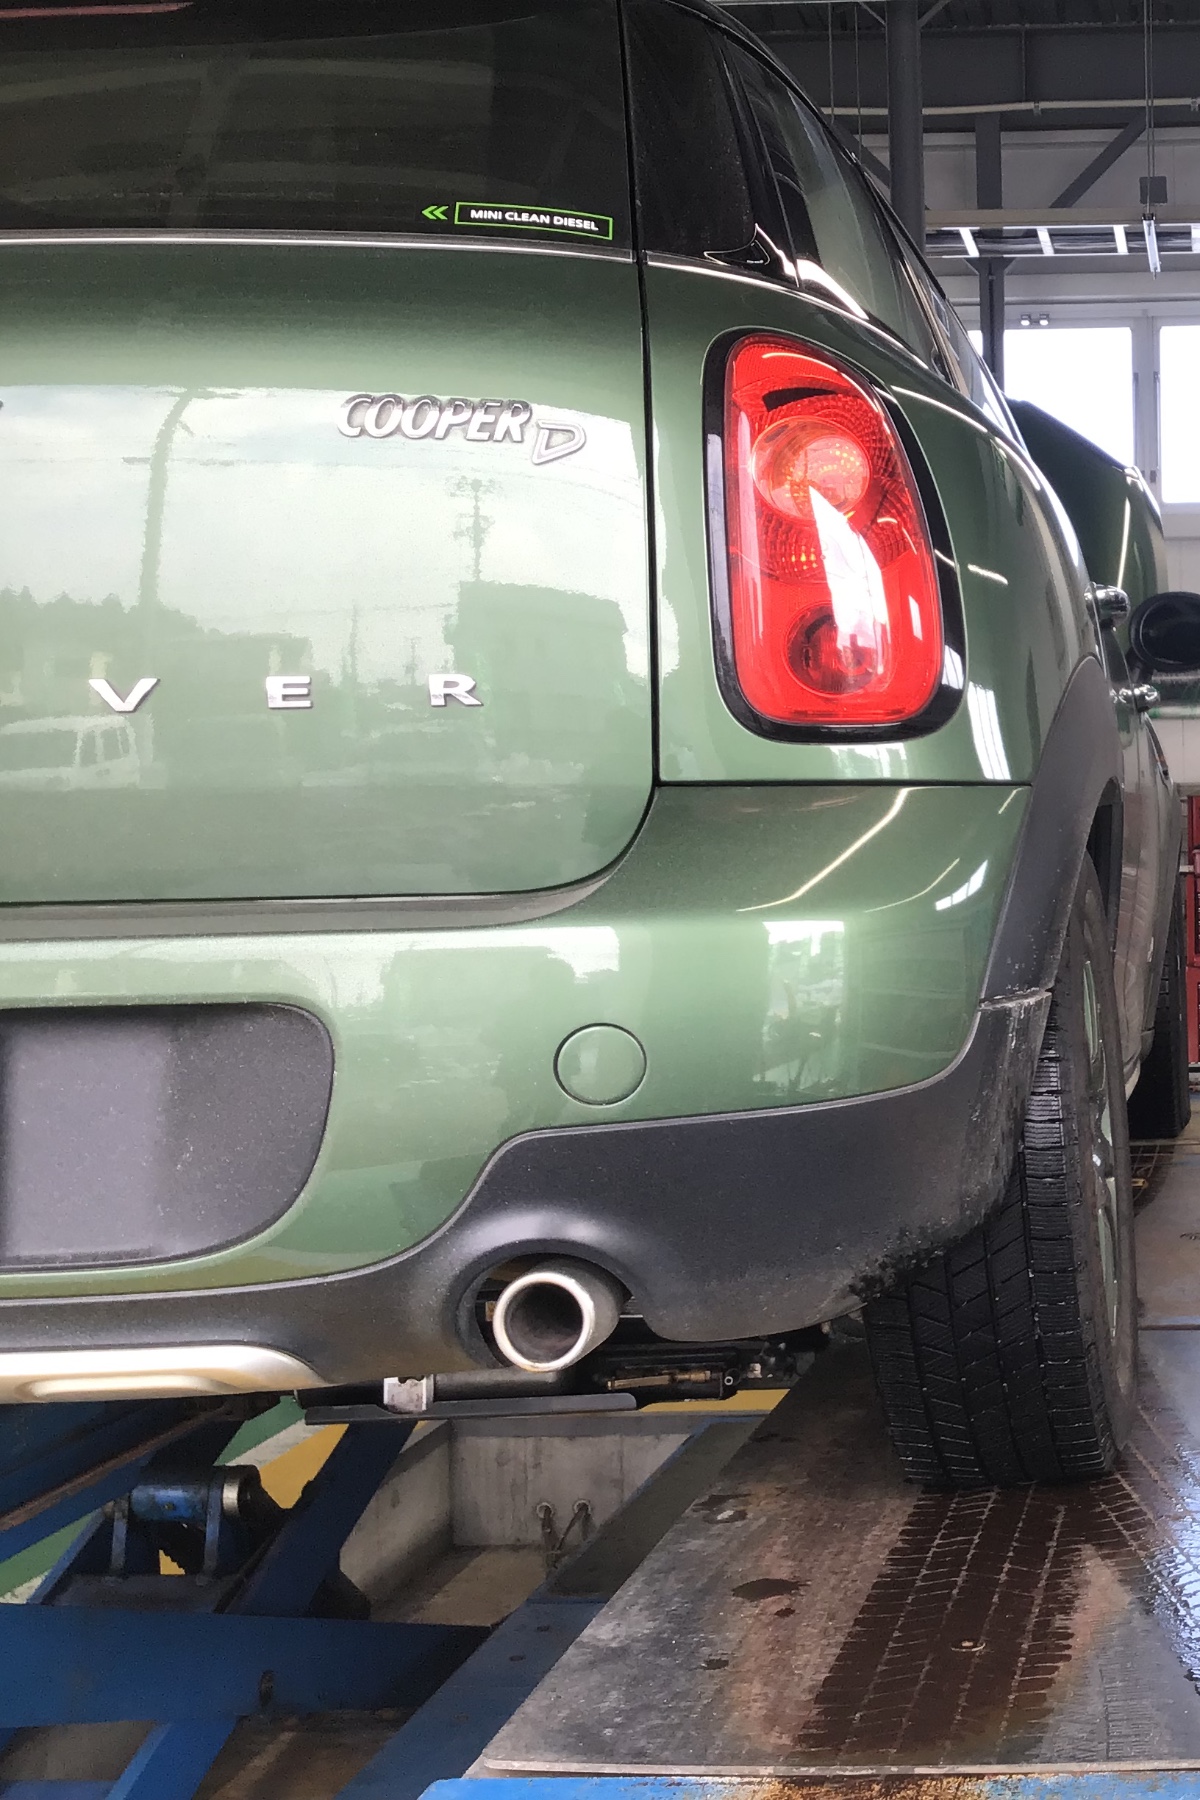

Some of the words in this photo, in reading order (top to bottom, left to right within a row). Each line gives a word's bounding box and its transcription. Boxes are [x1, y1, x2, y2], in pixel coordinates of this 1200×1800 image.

[470, 209, 502, 220] MINI
[504, 211, 550, 224] CLEAN
[553, 215, 599, 231] DIESEL
[336, 394, 532, 443] COOPER
[530, 418, 586, 465] D
